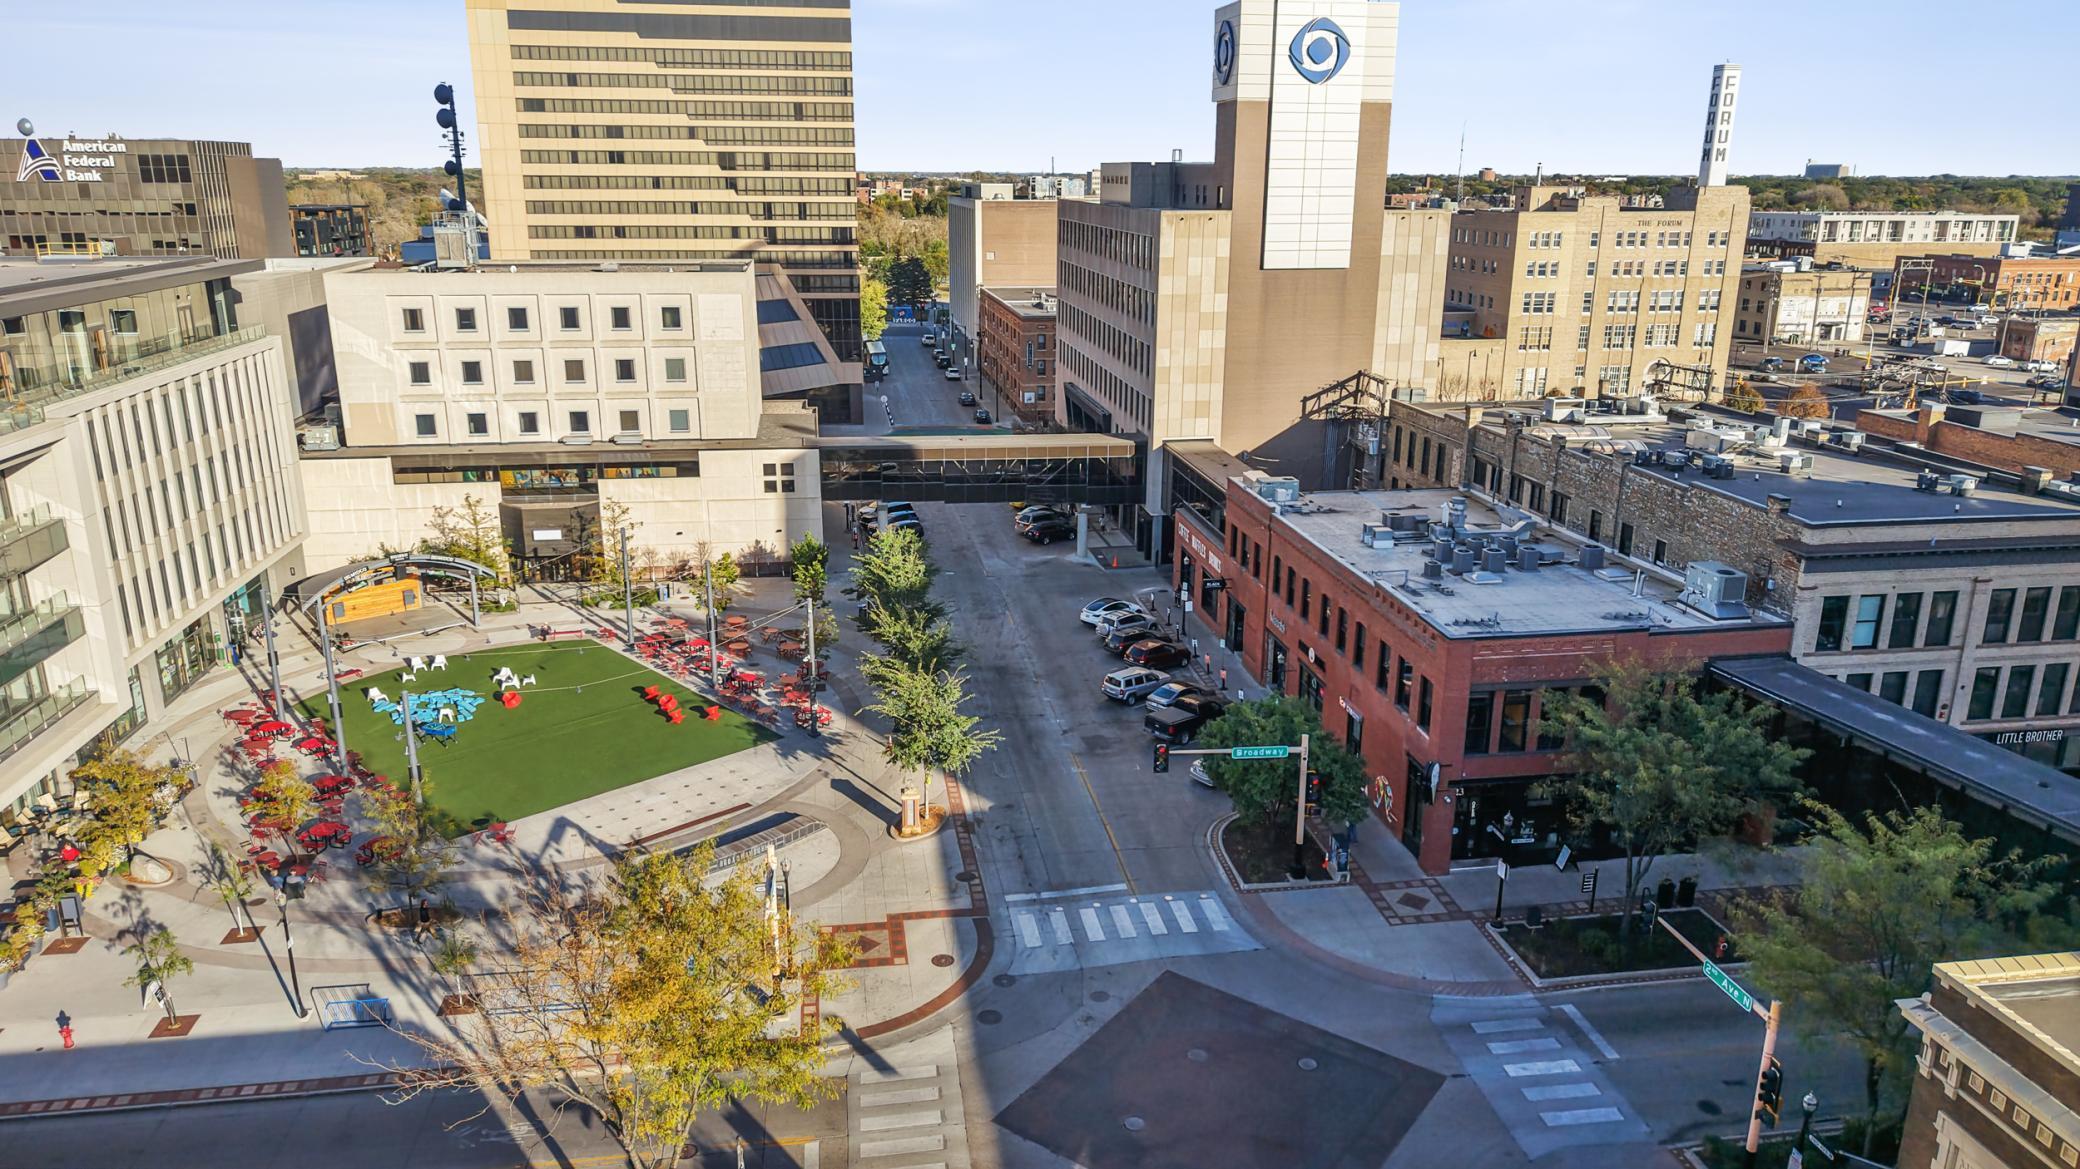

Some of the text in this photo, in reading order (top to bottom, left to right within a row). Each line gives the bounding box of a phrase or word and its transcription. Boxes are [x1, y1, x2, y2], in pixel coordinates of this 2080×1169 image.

[1702, 75, 1720, 162] FORUM
[1714, 75, 1737, 162] FORUM
[63, 139, 127, 153] American
[63, 155, 115, 168] Federal
[66, 169, 103, 182] Bank
[1996, 729, 2063, 745] LITTLE BROTHER
[1236, 749, 1284, 757] Broadway
[1721, 978, 1739, 998] Ave
[1742, 995, 1750, 1008] N
